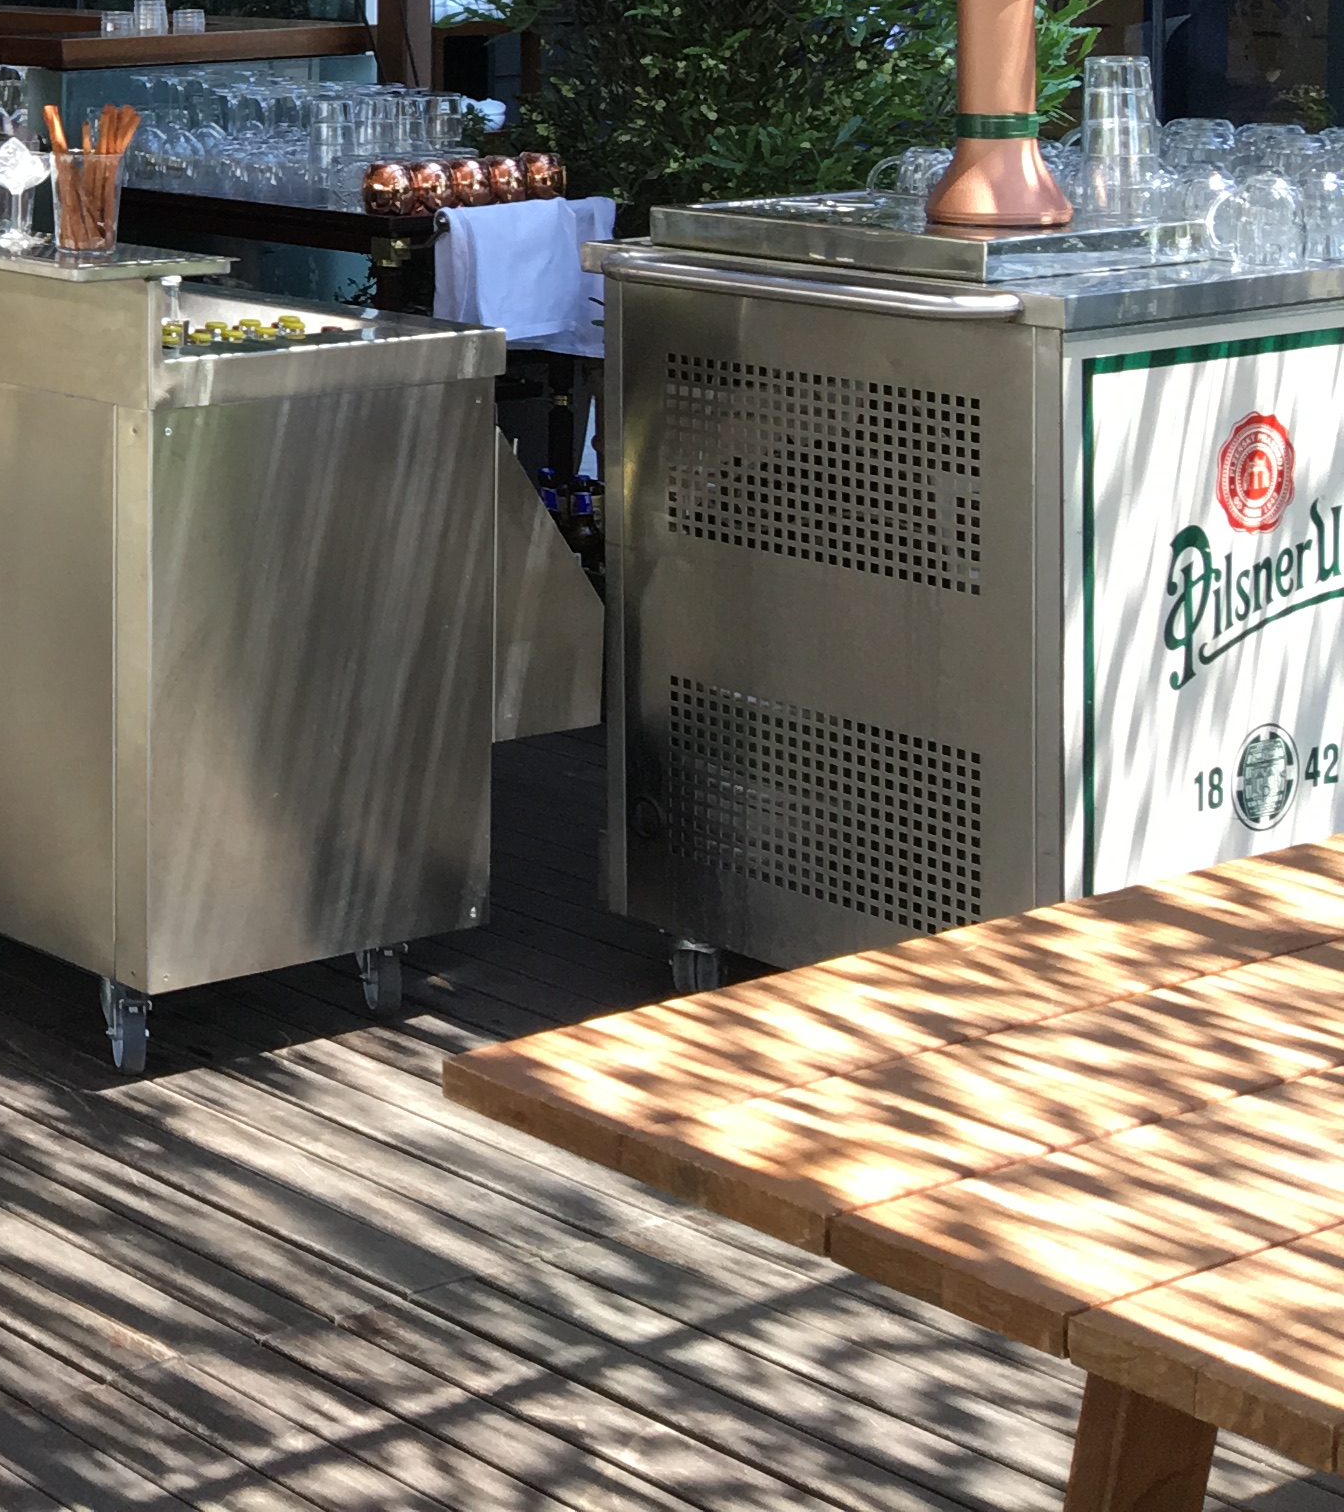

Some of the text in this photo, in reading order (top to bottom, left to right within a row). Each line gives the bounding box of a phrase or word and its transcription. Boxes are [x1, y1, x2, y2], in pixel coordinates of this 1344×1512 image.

[1164, 525, 1313, 690] Pilsner
[1194, 767, 1224, 811] 18
[1305, 743, 1339, 787] 42
